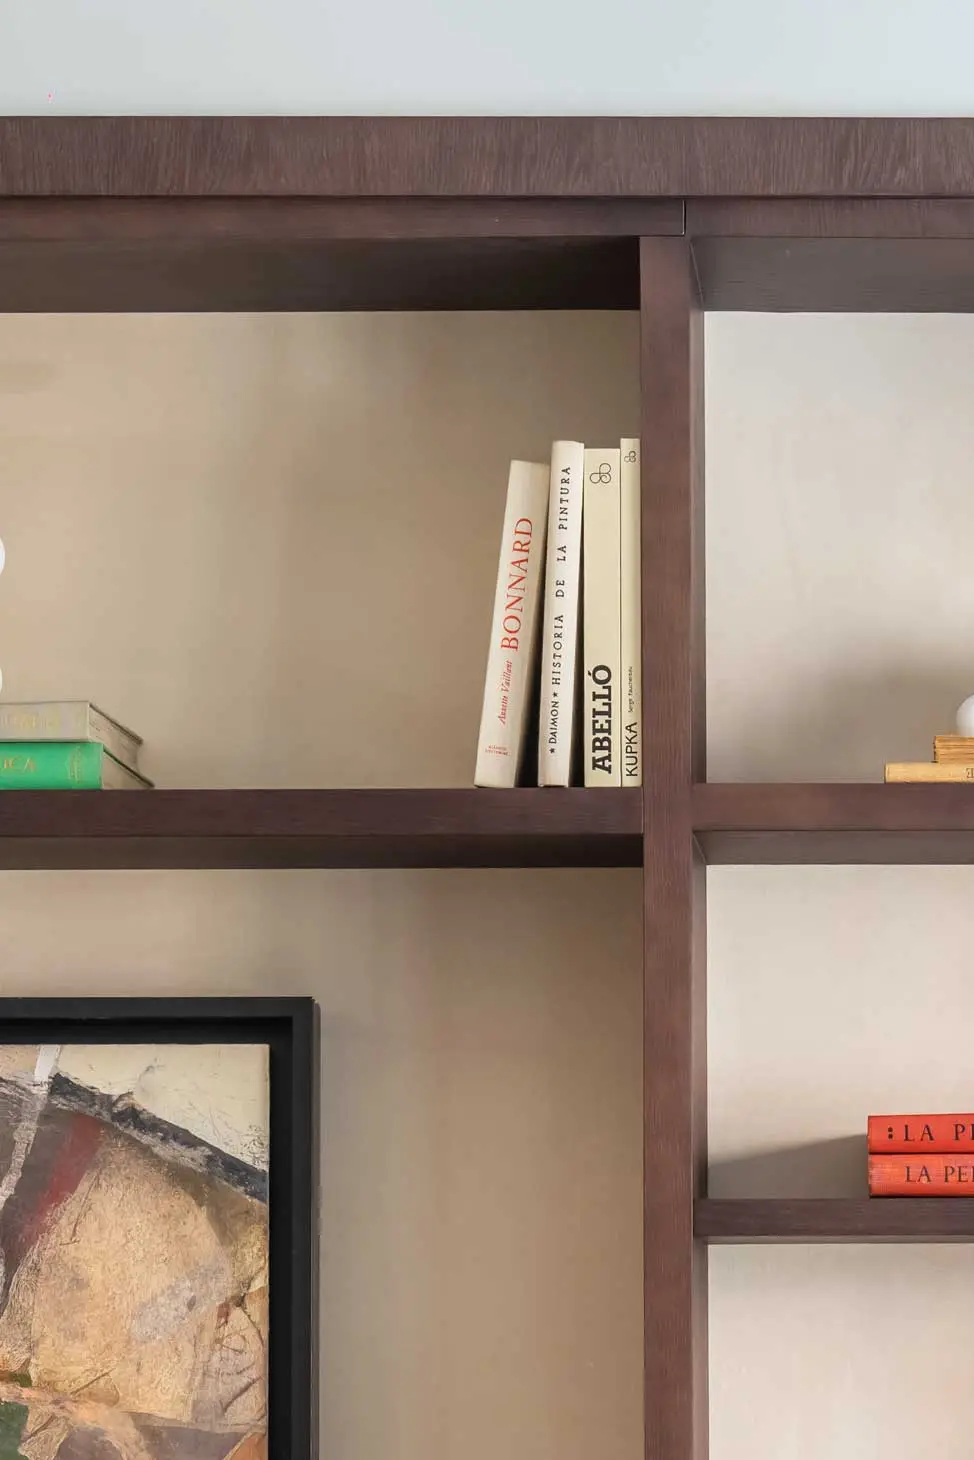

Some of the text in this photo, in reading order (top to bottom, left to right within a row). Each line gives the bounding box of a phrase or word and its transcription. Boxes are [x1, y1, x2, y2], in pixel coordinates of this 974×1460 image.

[500, 517, 533, 652] BONNARD
[549, 466, 571, 744] DAIMON HISTORIA DE LA PINTURA
[588, 663, 612, 774] ABELLÓ
[625, 722, 638, 777] KUPKA
[904, 1124, 934, 1142] LA
[905, 1165, 931, 1183] LA
